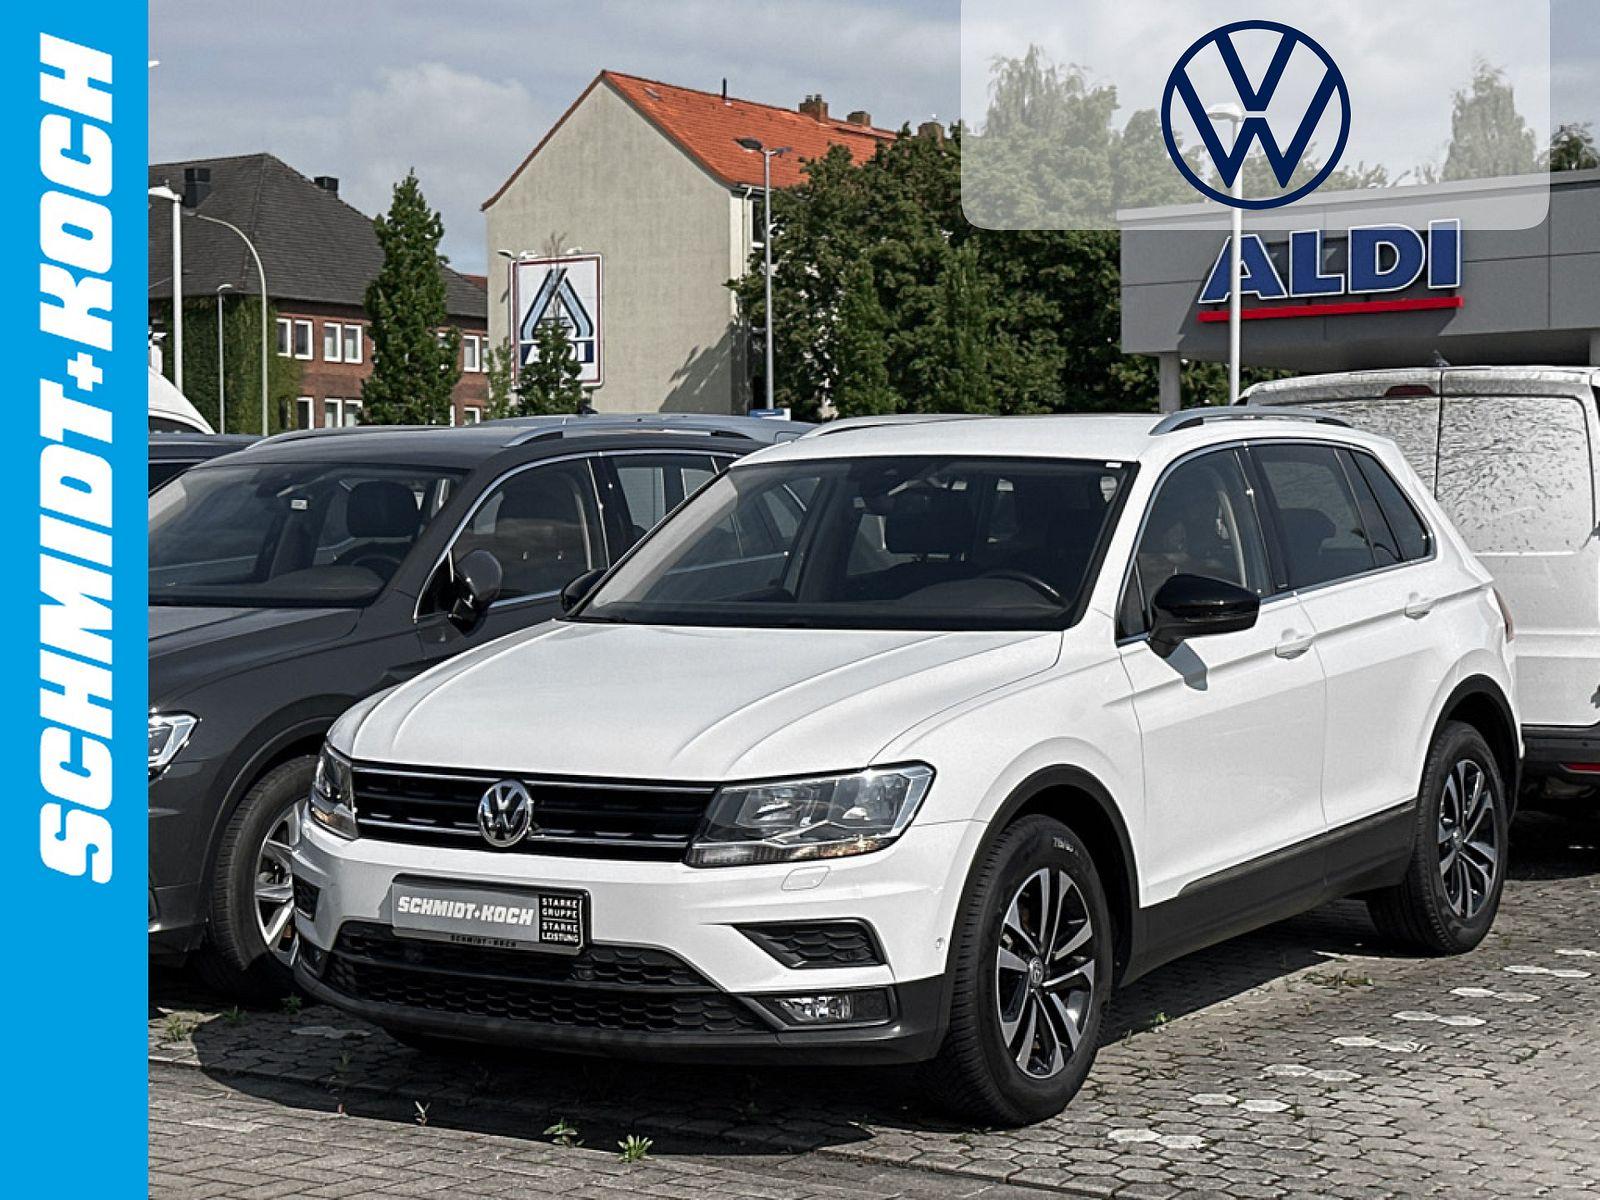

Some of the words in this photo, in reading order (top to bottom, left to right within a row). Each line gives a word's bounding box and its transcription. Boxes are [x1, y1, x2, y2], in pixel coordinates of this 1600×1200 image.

[1198, 218, 1461, 303] ALDI
[541, 897, 578, 909] STARKE
[397, 896, 534, 926] SCHMIDT+KOCH
[541, 907, 578, 919] GRUPPE
[541, 921, 579, 934] STARKE
[541, 931, 579, 943] LEISTUNG
